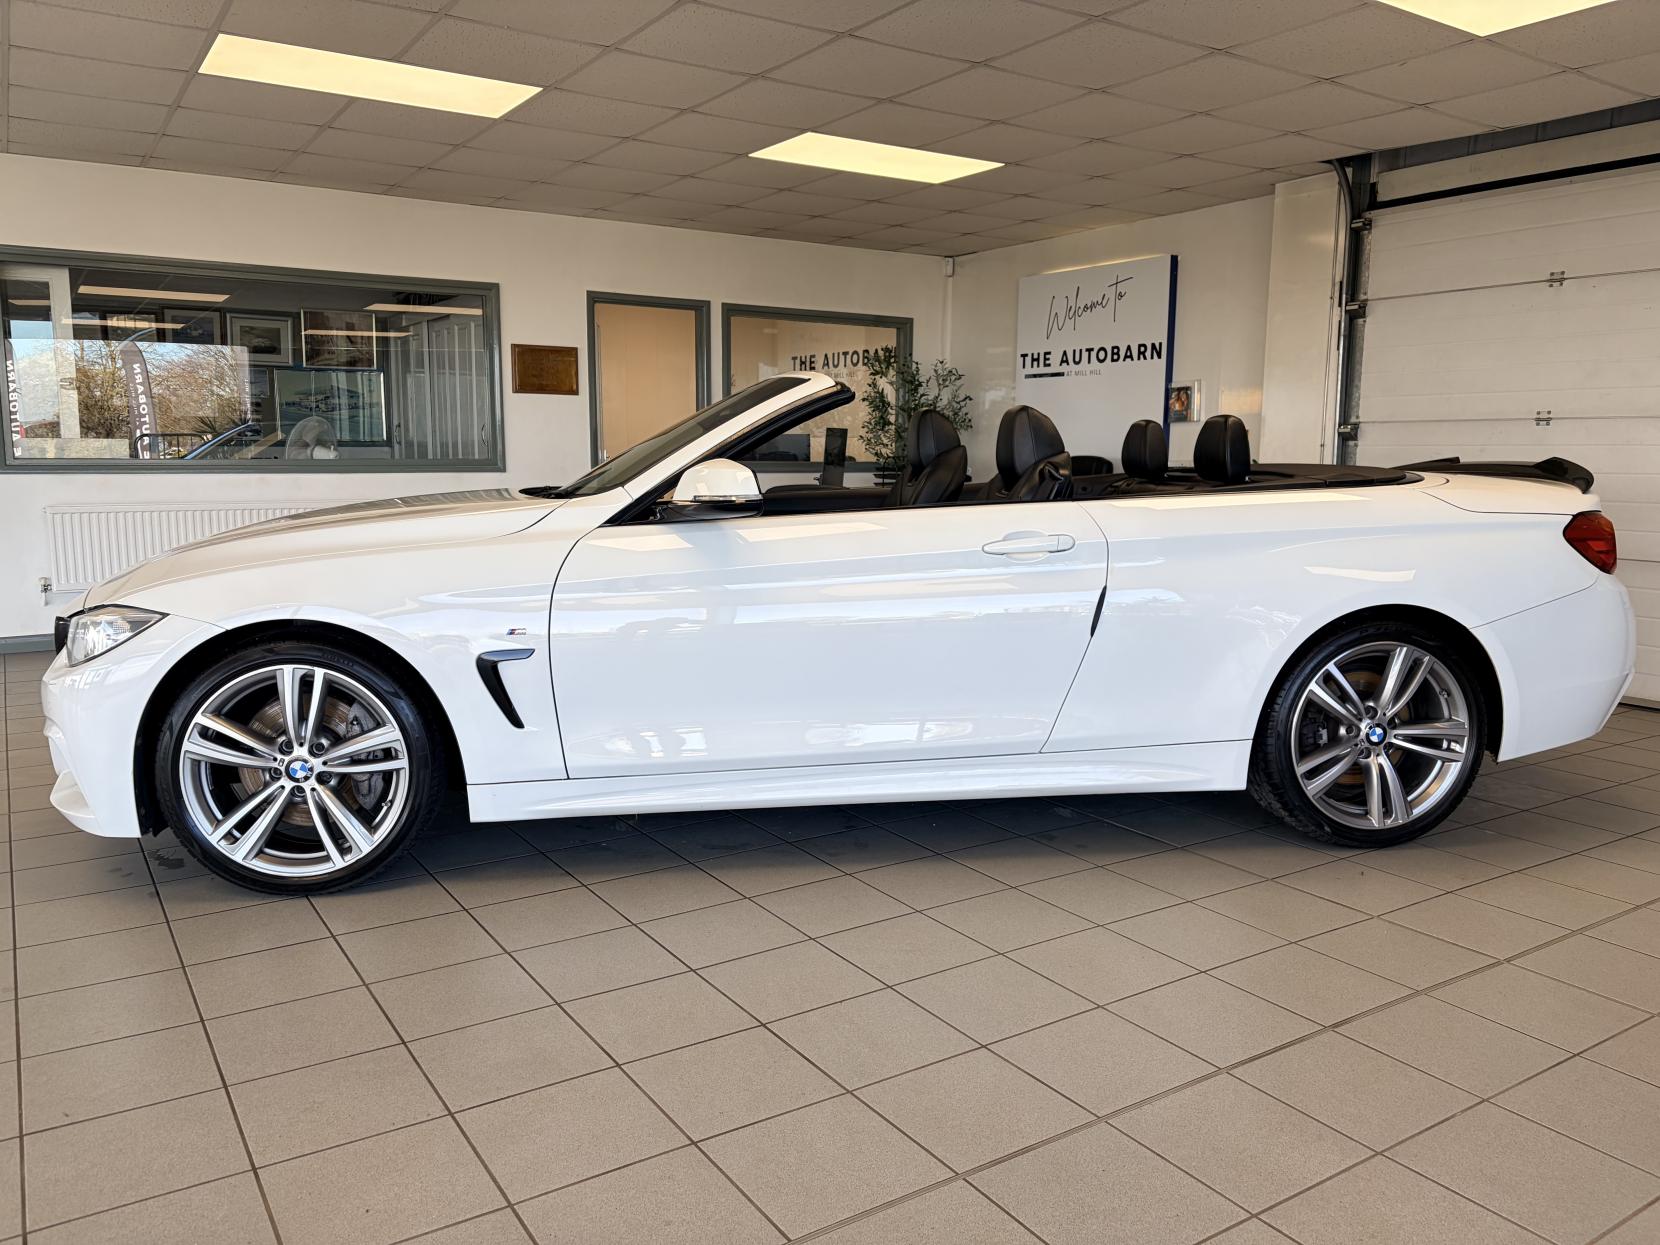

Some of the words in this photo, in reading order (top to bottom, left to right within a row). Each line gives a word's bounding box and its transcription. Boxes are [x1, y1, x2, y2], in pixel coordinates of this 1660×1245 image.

[1046, 286, 1110, 340] Welcome
[791, 354, 817, 371] THE
[1020, 351, 1052, 369] THE
[1059, 342, 1163, 367] AUTOBARN
